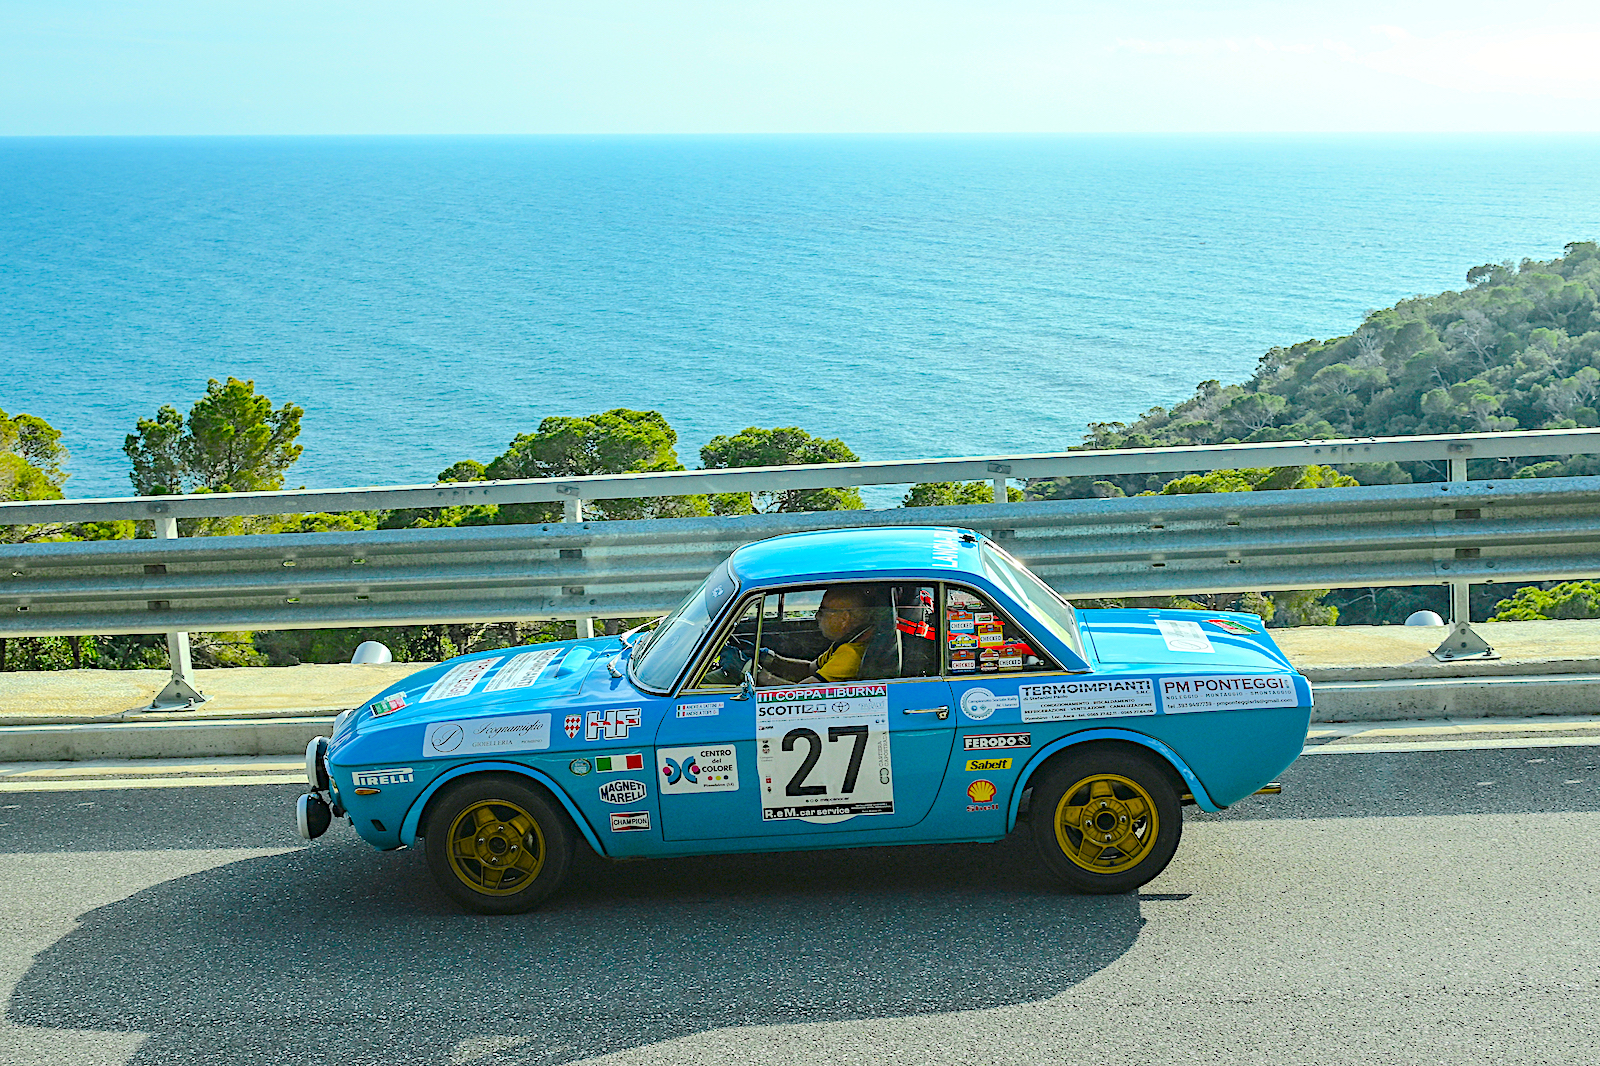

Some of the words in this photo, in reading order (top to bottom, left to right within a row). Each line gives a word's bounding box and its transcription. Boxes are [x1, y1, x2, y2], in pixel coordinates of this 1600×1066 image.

[1022, 680, 1151, 697] TERMOIMPIANTI
[1164, 681, 1190, 693] PM
[1194, 678, 1284, 692] PONTEGGI
[758, 693, 773, 702] III
[776, 689, 822, 701] COPPA
[825, 686, 885, 699] LIBURNA
[758, 705, 804, 717] SCOTTI
[585, 708, 641, 741] HF
[964, 736, 1017, 748] FERODO
[700, 749, 732, 758] CENTRO
[781, 725, 869, 796] 27
[970, 759, 1008, 770] Sabelt
[701, 764, 733, 773] COLORE
[352, 767, 414, 786] PIRELLI
[800, 809, 815, 817] car
[816, 806, 850, 816] service
[966, 803, 999, 812] Shell
[613, 817, 647, 826] CHAMPION
